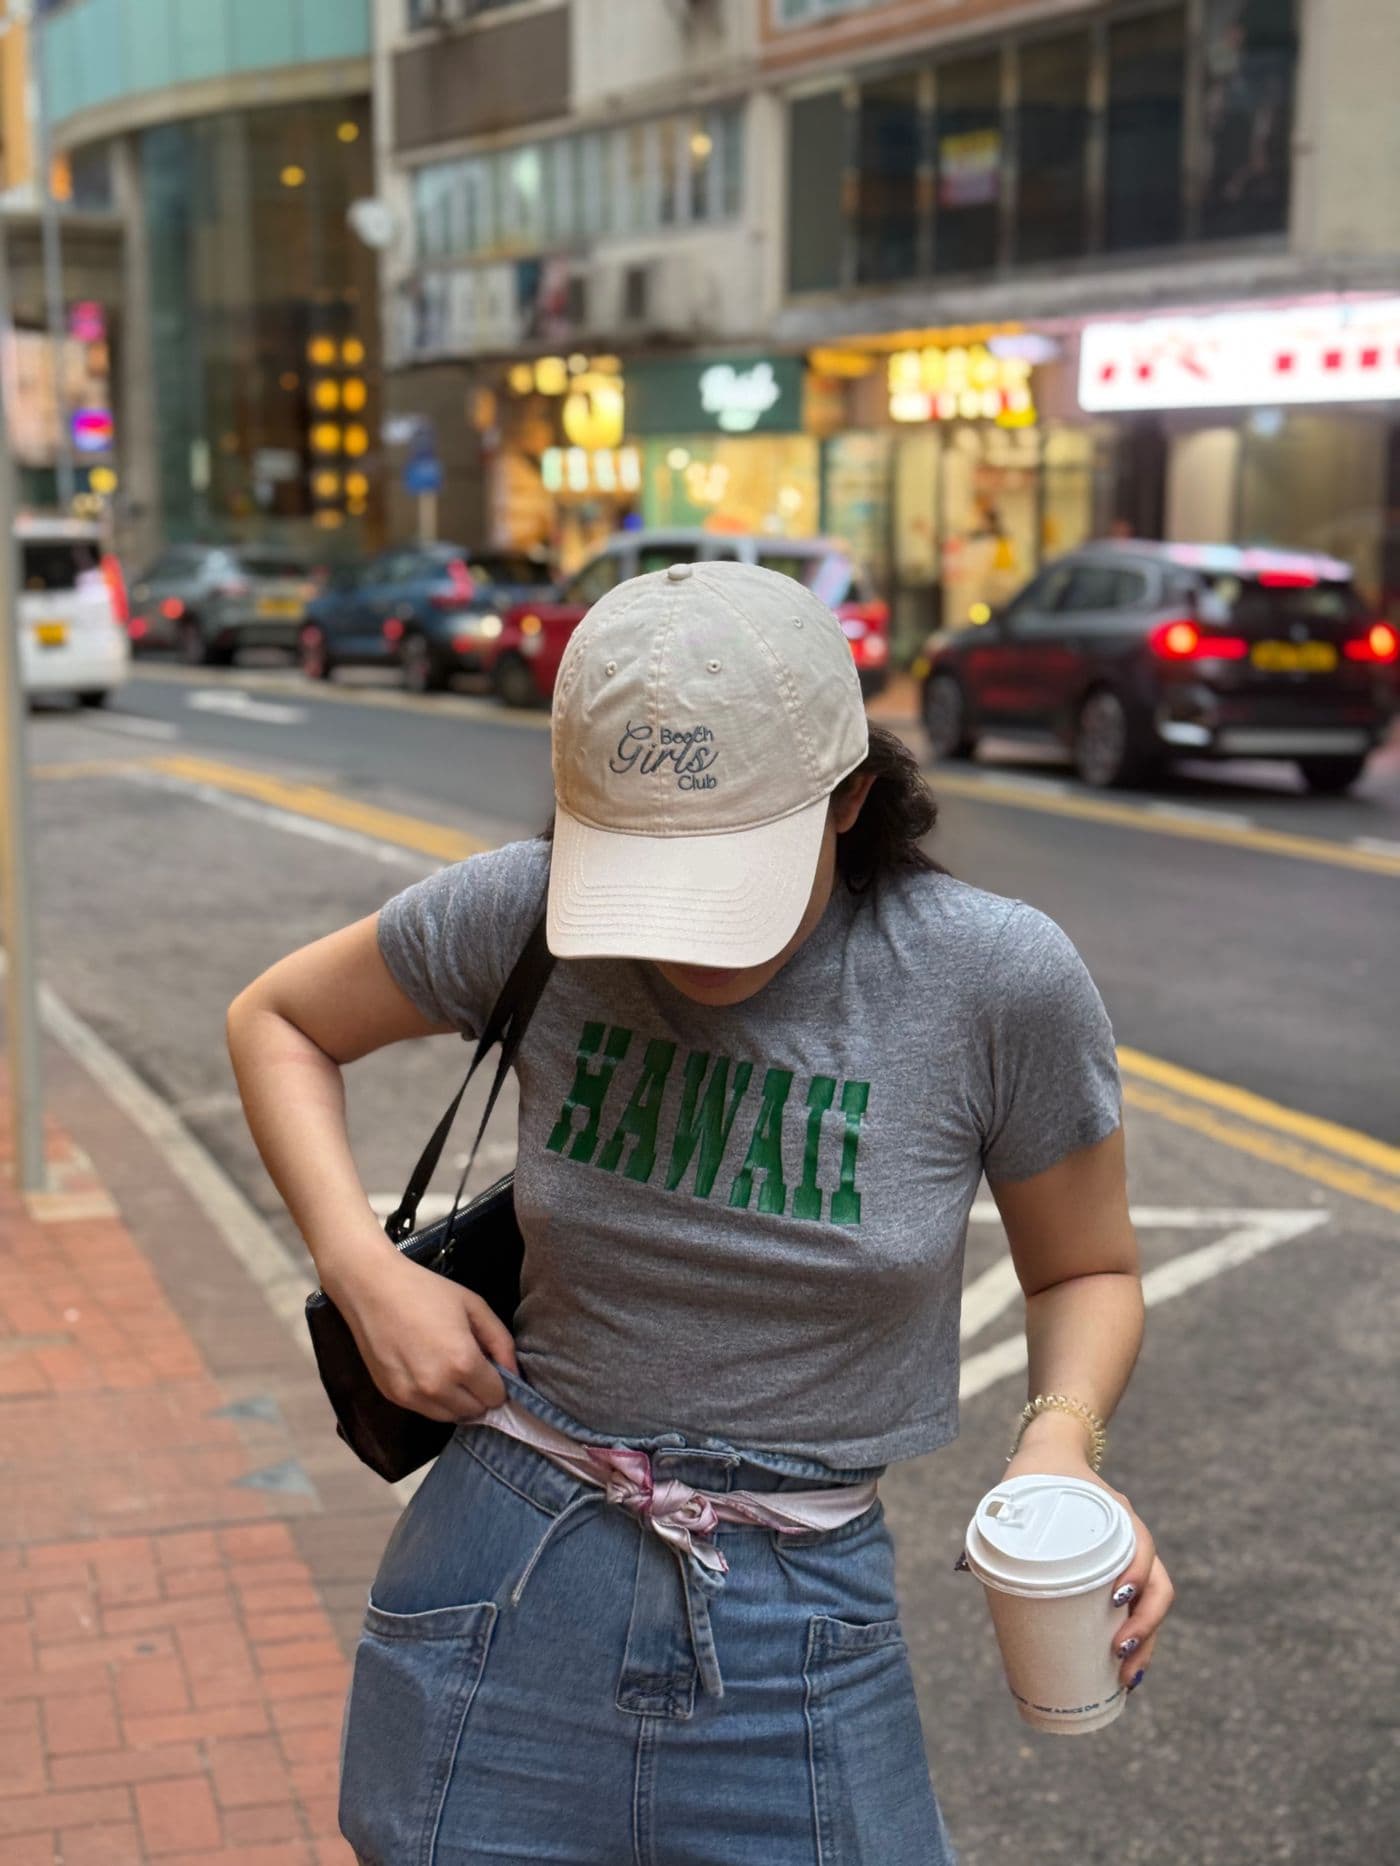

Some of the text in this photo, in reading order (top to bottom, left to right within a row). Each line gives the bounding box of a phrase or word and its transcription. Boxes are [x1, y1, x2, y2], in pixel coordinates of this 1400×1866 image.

[609, 720, 719, 774] Girls
[660, 725, 715, 745] Beach
[677, 774, 718, 790] Club
[546, 1021, 871, 1225] HAWAII
